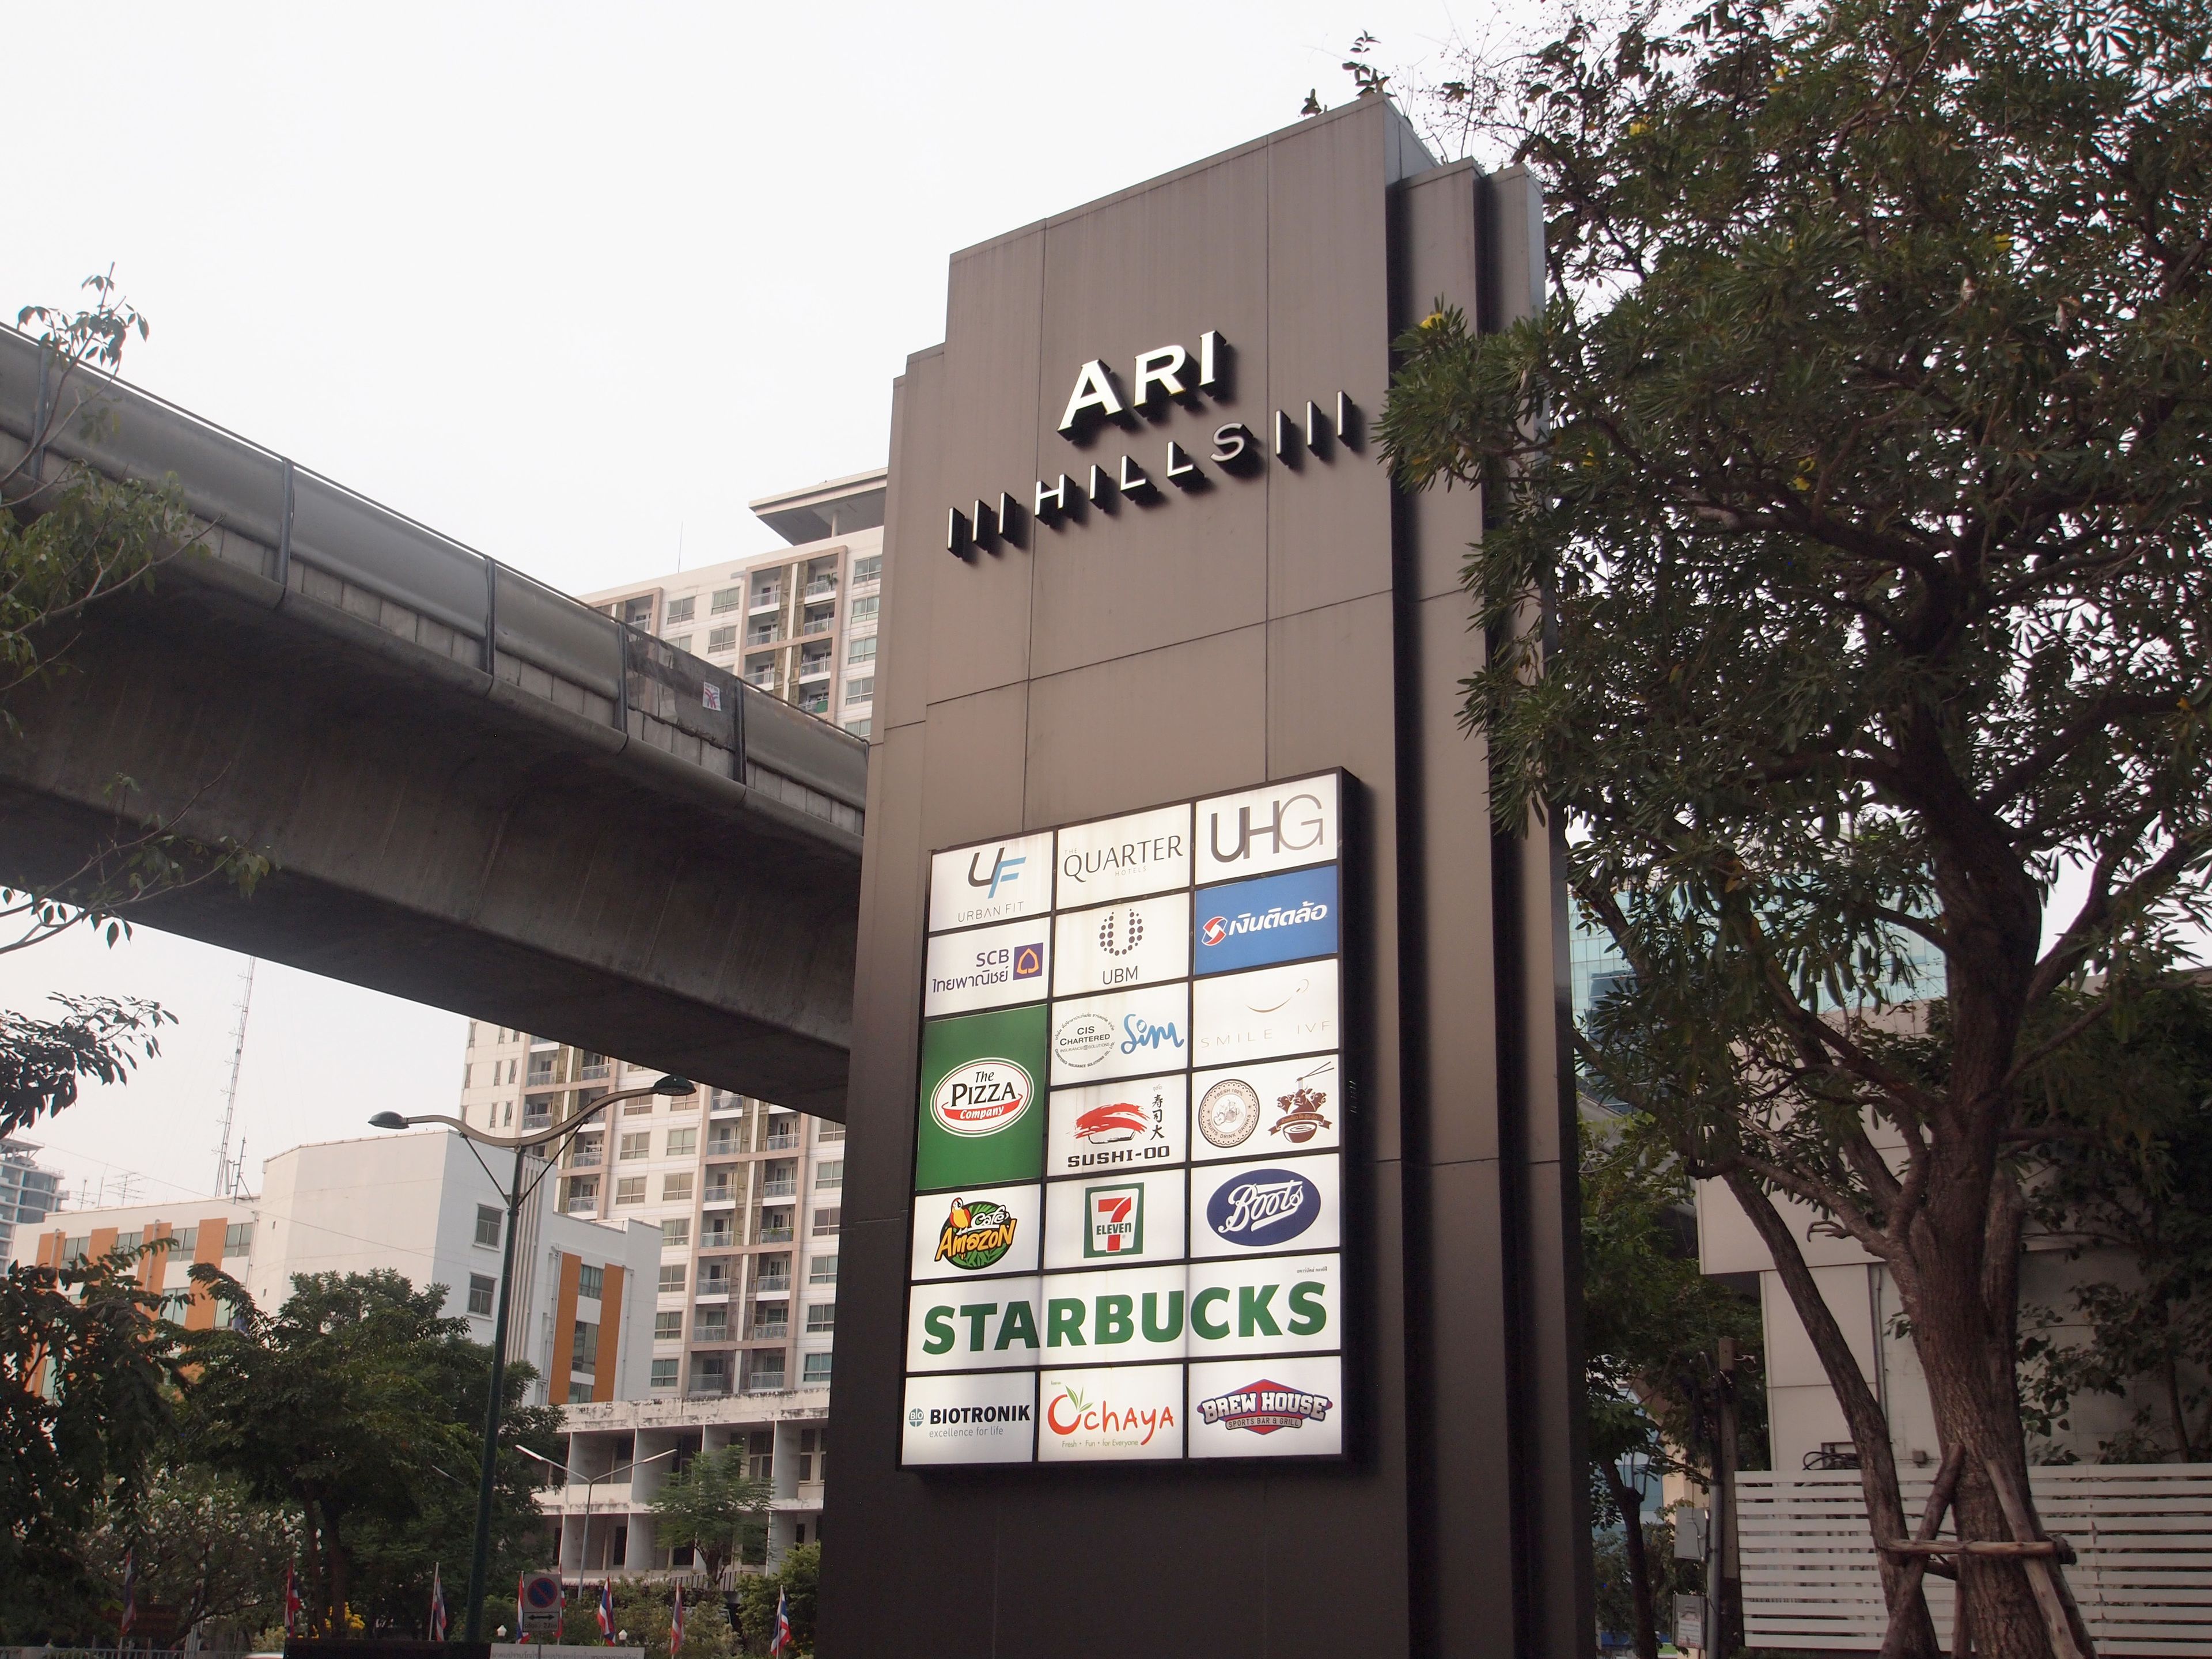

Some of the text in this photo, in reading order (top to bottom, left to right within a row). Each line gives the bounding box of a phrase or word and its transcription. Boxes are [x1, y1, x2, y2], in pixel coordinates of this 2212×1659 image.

[1057, 330, 1217, 433] ARI
[1035, 423, 1245, 518] HILLS
[1211, 794, 1323, 863] UHG
[1063, 835, 1184, 882] QUARTER
[1064, 847, 1077, 855] THE
[1115, 865, 1147, 877] HOTELS
[957, 901, 1024, 922] URBAN FIT
[1228, 900, 1328, 936] เงินติดล้อ
[976, 948, 1009, 968] SCB
[932, 965, 1009, 993] ไทยพาณิชย์
[1103, 965, 1138, 985] UBM
[1059, 1033, 1111, 1047] CHARTERED
[1077, 1025, 1095, 1036] CIS
[1200, 1020, 1332, 1048] SMILE IVF
[975, 1071, 995, 1084] The
[950, 1081, 1017, 1107] PIZZA
[1213, 1088, 1231, 1100] FRESH
[959, 1105, 1005, 1120] Company
[1237, 1114, 1252, 1135] DRINKS
[1218, 1179, 1304, 1233] Boots
[1097, 1196, 1132, 1252] 7
[922, 1280, 1328, 1355] STARBUCKS
[929, 1404, 1031, 1425] BIOTRONIK
[1202, 1391, 1330, 1423] BREW HOUSE
[929, 1425, 1004, 1438] excellence for life
[1228, 1418, 1255, 1429] SPORTS
[1279, 1418, 1300, 1427] GRILL
[1062, 1440, 1077, 1448] Fresh
[1102, 1438, 1111, 1447] for
[1112, 1438, 1139, 1448] Everyone
